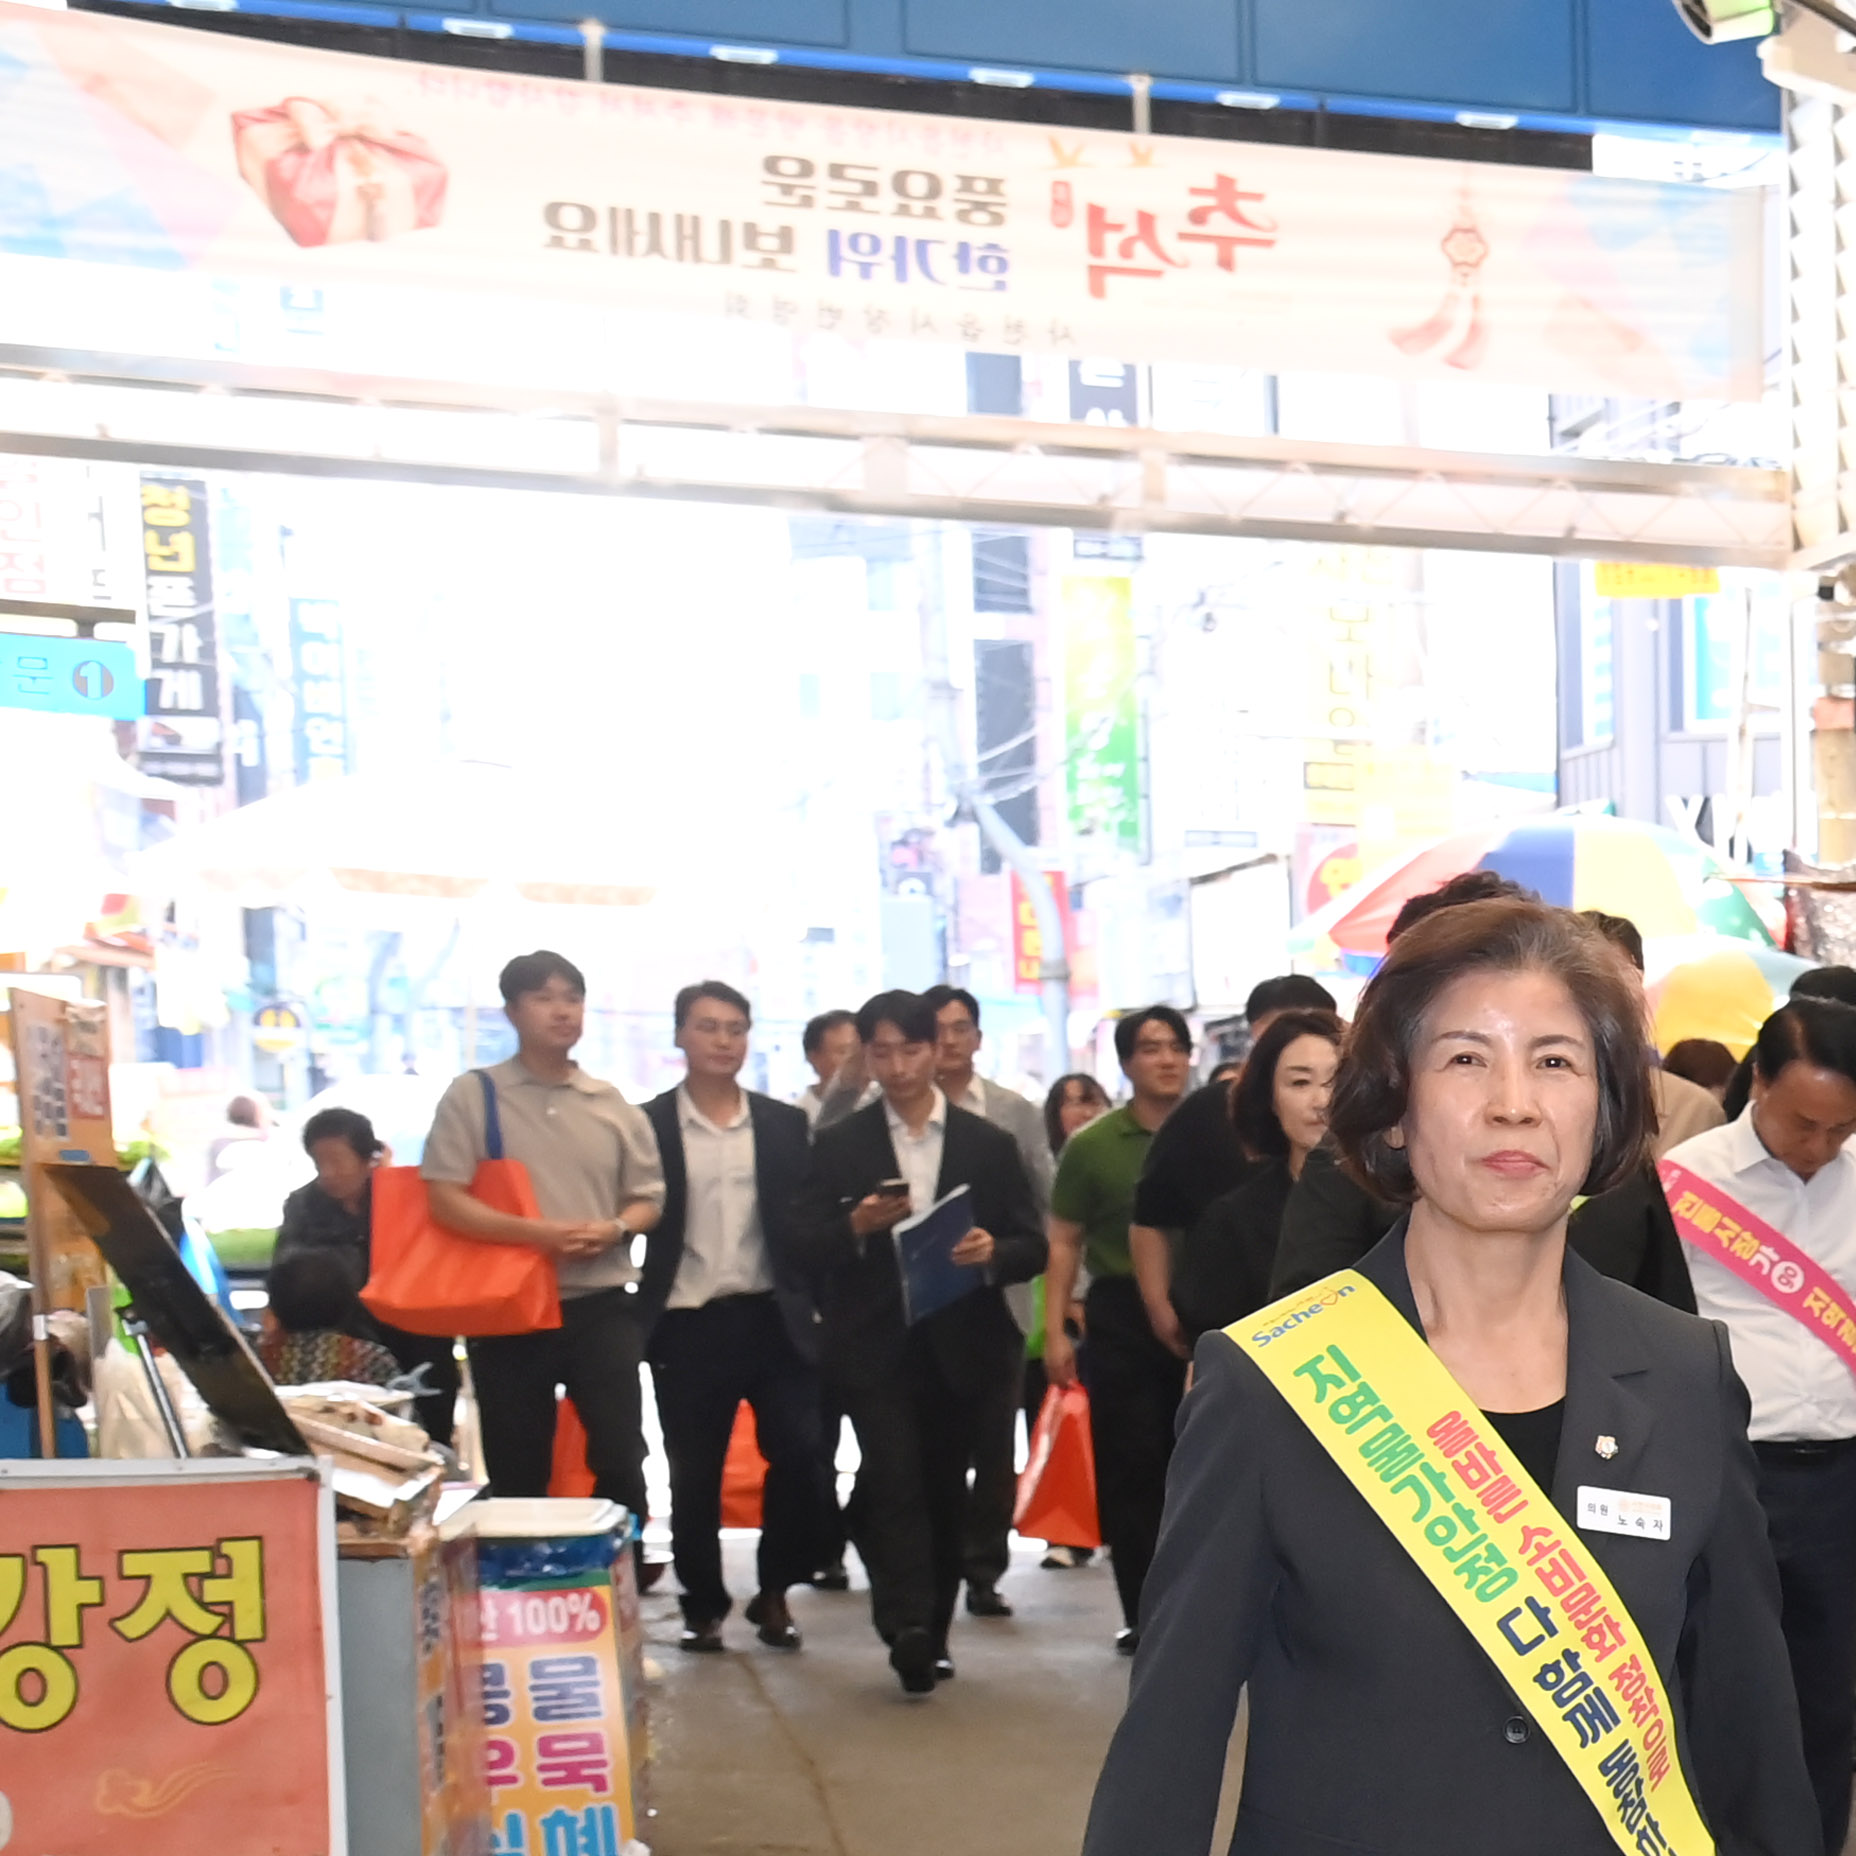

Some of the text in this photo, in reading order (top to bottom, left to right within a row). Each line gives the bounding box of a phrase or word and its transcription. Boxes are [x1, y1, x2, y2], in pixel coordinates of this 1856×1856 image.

[0, 1535, 267, 1732] 강정
[507, 1593, 601, 1636] 100%
[1426, 1408, 1525, 1528] 올바른
[1516, 1522, 1627, 1666] 소비문화
